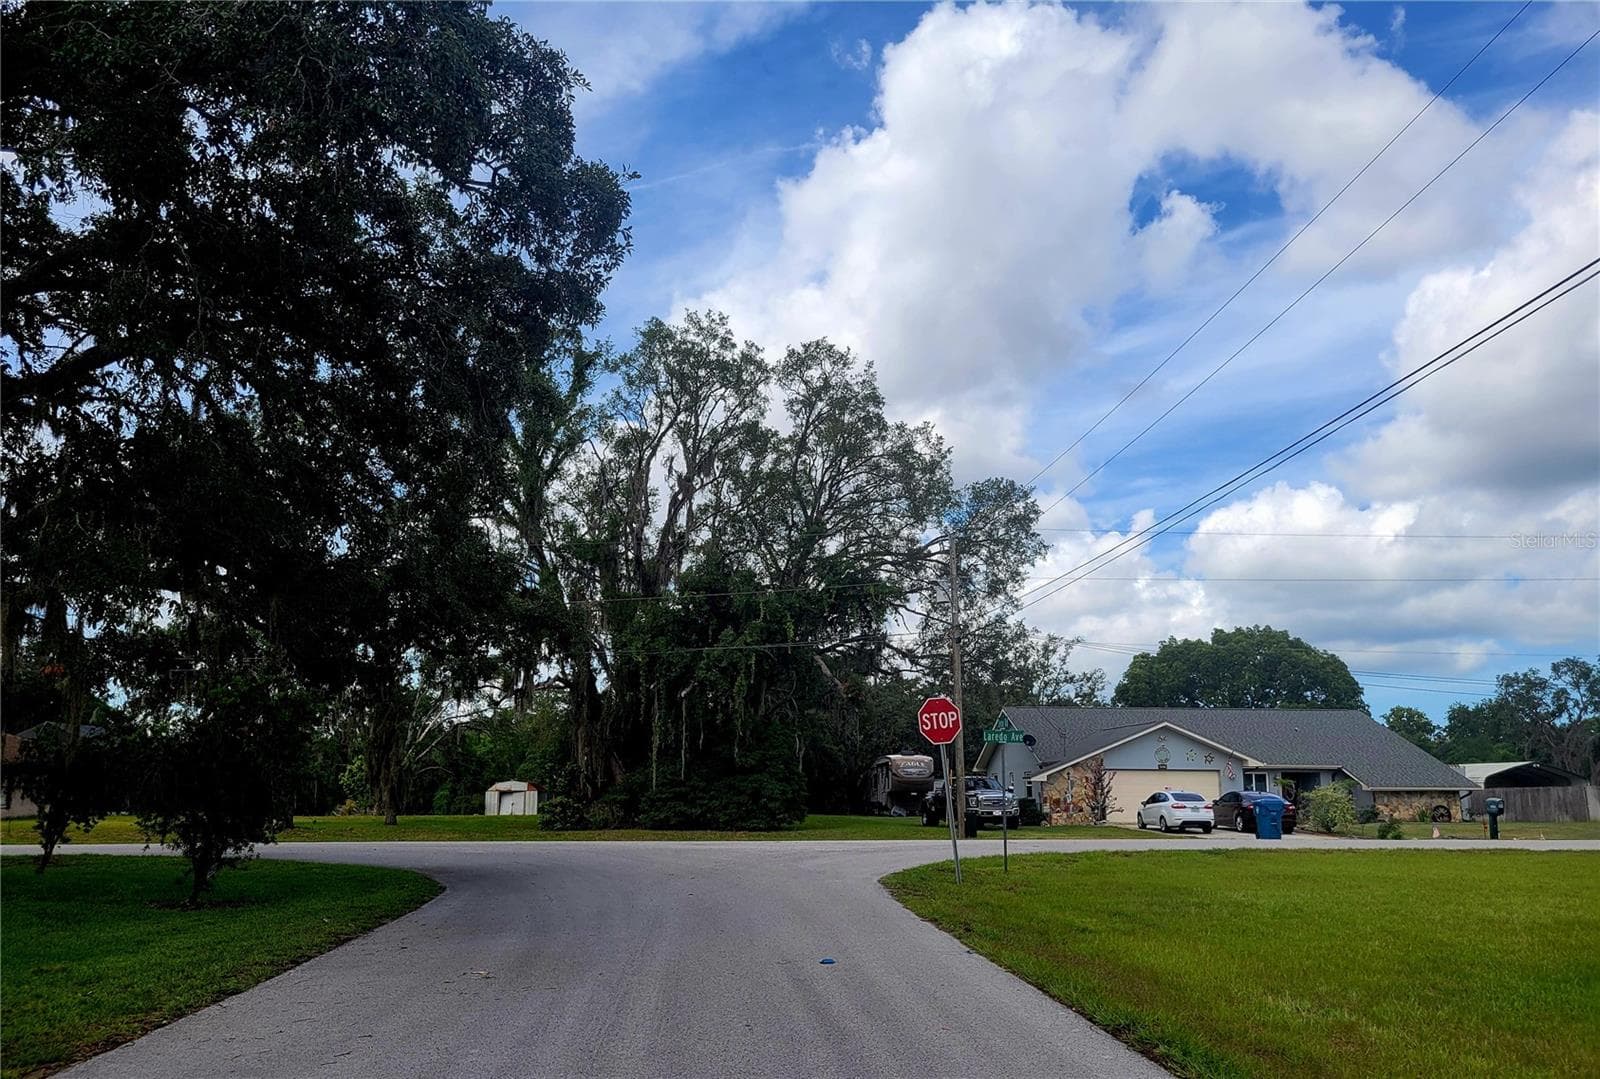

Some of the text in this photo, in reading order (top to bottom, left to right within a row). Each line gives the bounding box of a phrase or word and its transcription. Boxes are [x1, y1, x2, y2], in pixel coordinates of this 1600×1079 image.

[922, 711, 957, 731] STOP
[983, 731, 1024, 741] Laredo Ave
